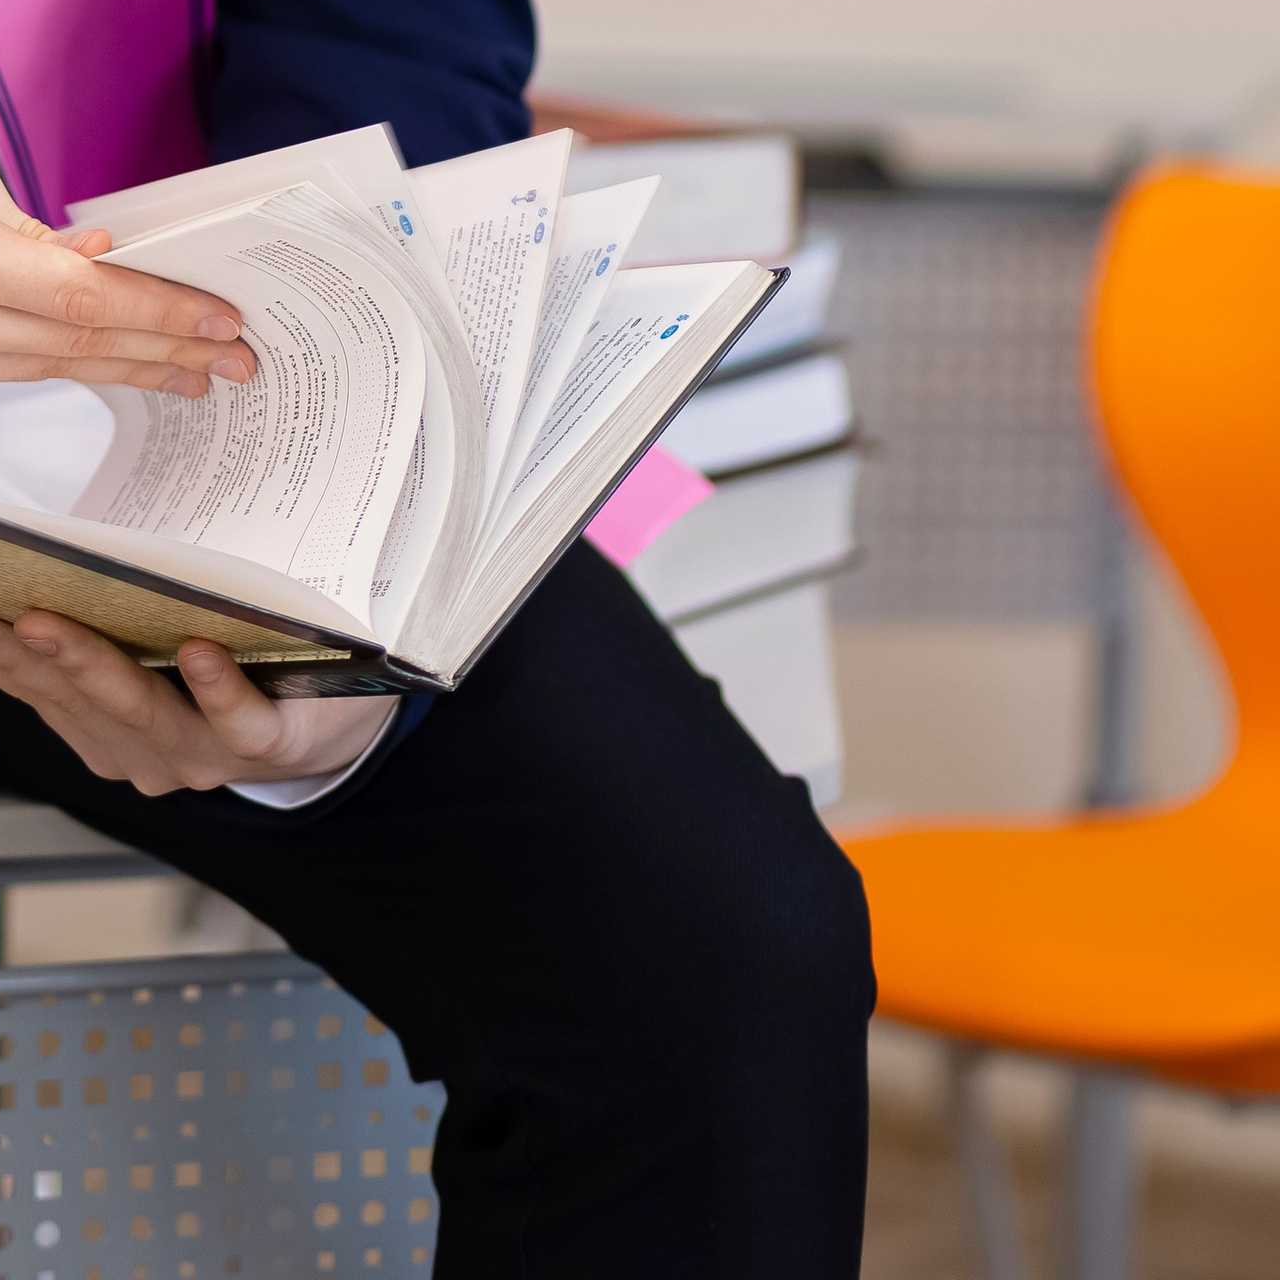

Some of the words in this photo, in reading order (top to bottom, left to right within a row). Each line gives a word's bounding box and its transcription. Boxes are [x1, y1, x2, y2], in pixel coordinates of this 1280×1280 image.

[242, 320, 282, 443] бщеобразовательных
[273, 345, 289, 399] Учебник
[289, 354, 301, 420] РУССКИЙ
[302, 352, 312, 420] Валентина
[331, 354, 339, 400] Учебное
[358, 286, 400, 365] Справочный
[386, 370, 400, 437] материал
[311, 368, 320, 428] Светлана
[315, 371, 327, 441] Маргарита
[484, 371, 502, 428] заключа
[282, 425, 297, 466] ЯЗЫК
[288, 425, 310, 484] Ивановна
[292, 432, 315, 491] Ивановна
[286, 445, 318, 519] Михайловна
